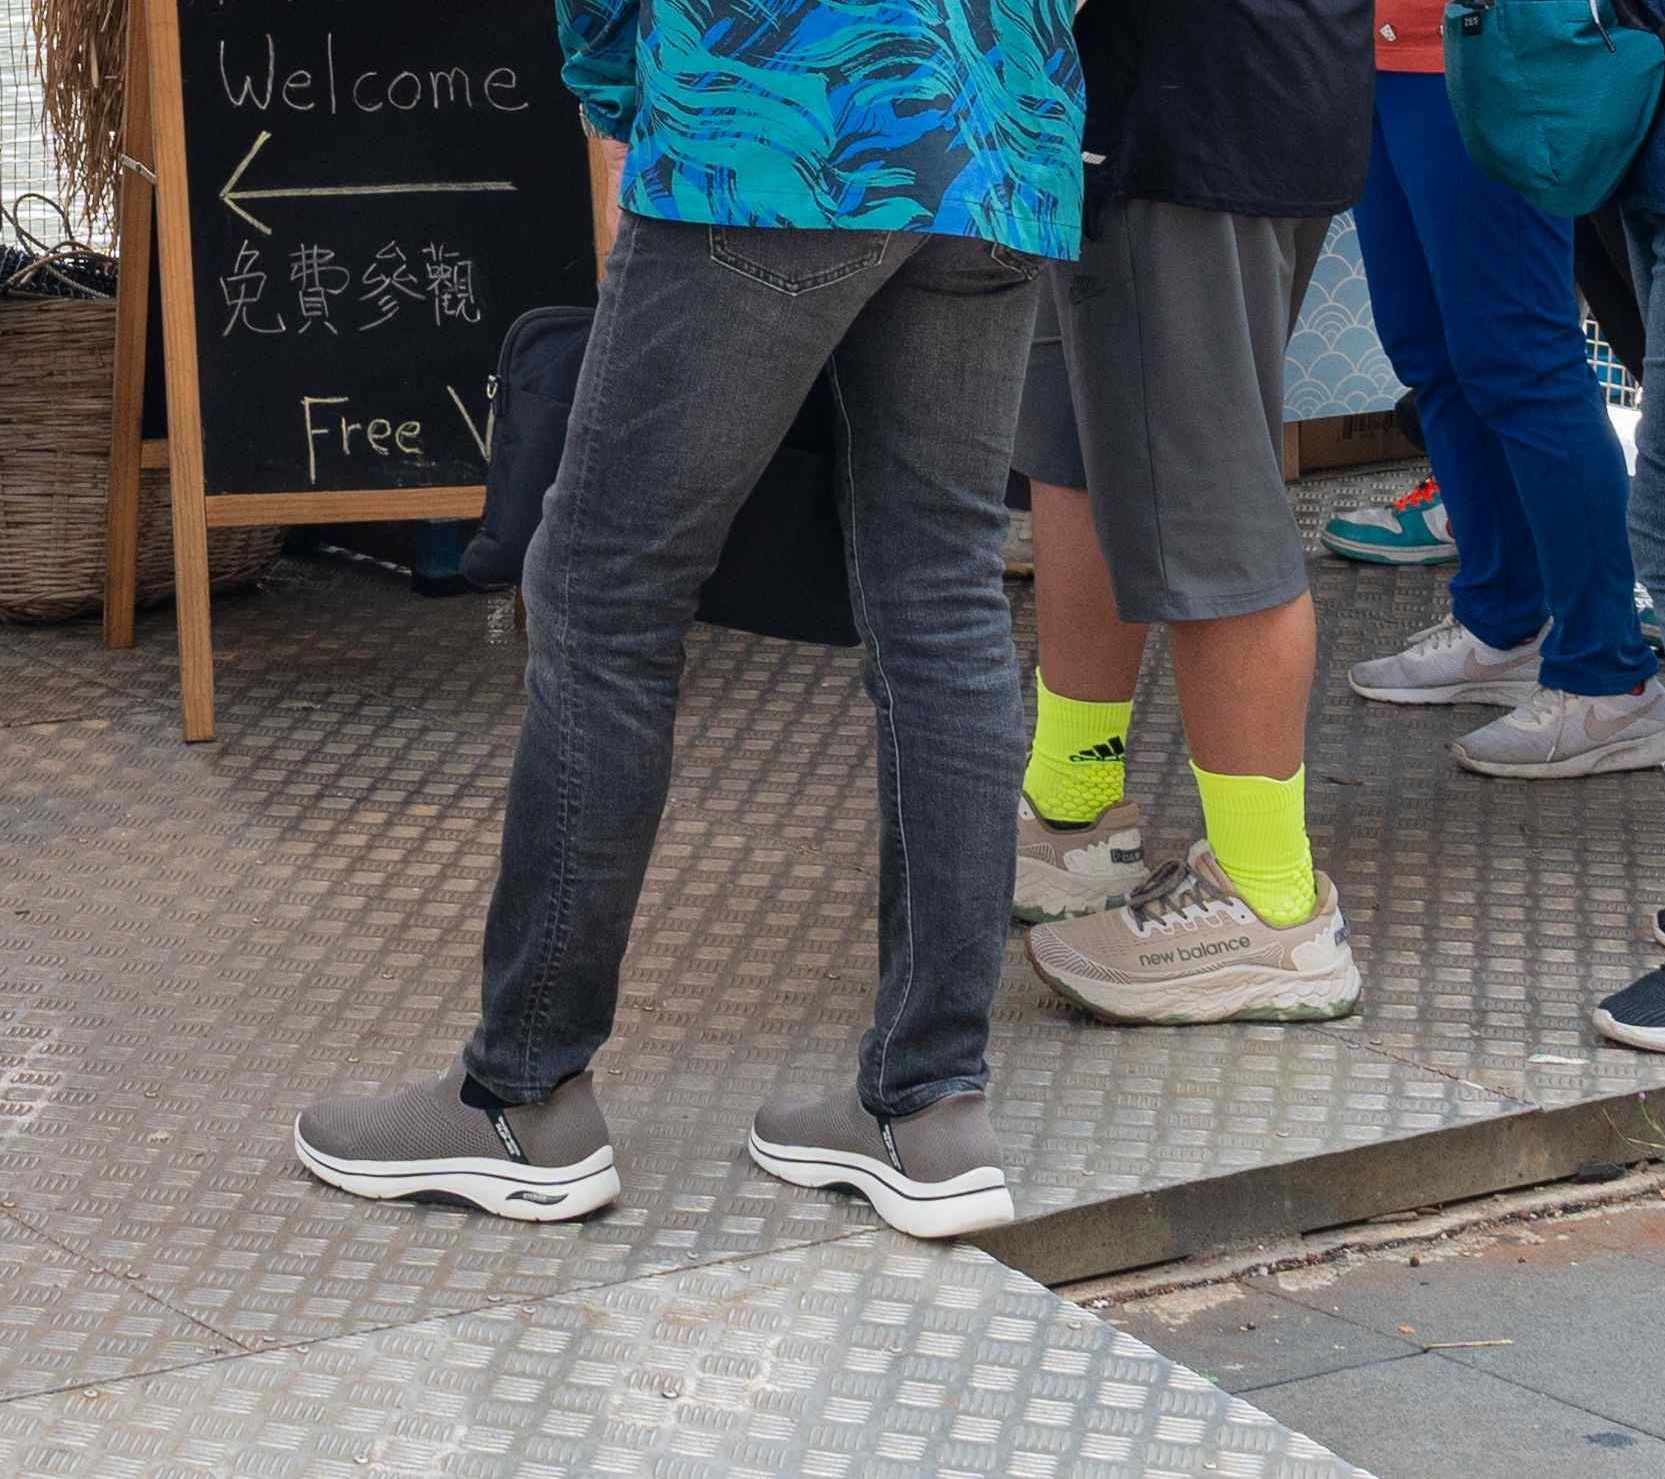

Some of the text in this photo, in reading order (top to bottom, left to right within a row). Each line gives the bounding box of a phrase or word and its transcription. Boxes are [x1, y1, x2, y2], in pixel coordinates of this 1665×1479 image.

[218, 32, 529, 114] Welcome
[218, 238, 482, 337] 免費參觀
[300, 394, 423, 485] Free
